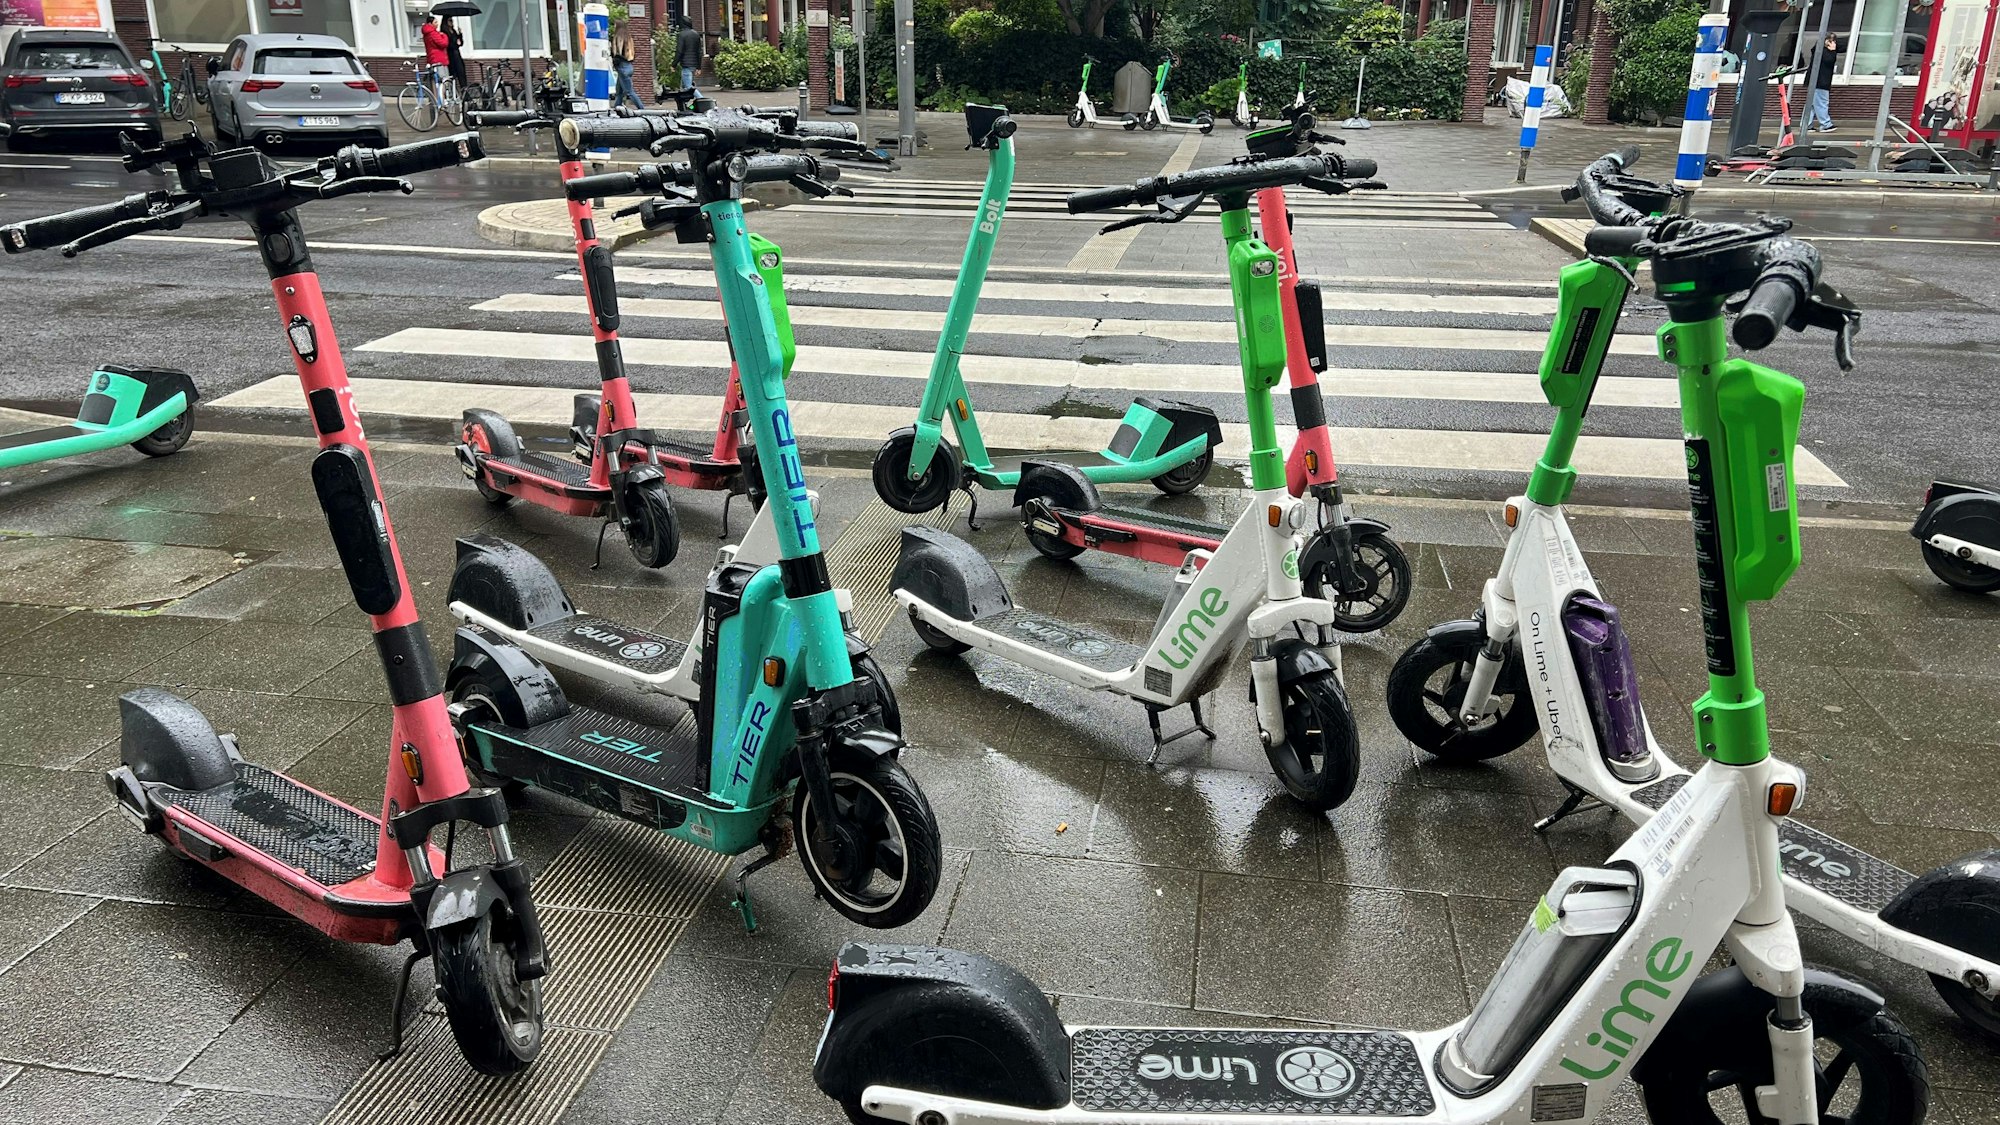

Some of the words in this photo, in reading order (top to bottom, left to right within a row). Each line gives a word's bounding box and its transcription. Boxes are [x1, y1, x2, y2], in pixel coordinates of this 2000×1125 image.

[1937, 45, 1947, 67] Kreuz
[1932, 66, 1944, 89] Heilig
[978, 197, 1003, 235] Bolt
[772, 408, 815, 550] TIER
[573, 625, 619, 649] Lime
[706, 606, 718, 648] TIER
[1016, 620, 1069, 645] Lime
[1158, 586, 1230, 671] Lime
[1529, 612, 1542, 639] On
[1532, 640, 1549, 686] Lime
[1546, 698, 1566, 743] Uber
[579, 729, 665, 765] TIER
[732, 699, 772, 786] TIER
[1559, 936, 1694, 1081] Lime
[1138, 1052, 1260, 1087] Lime
